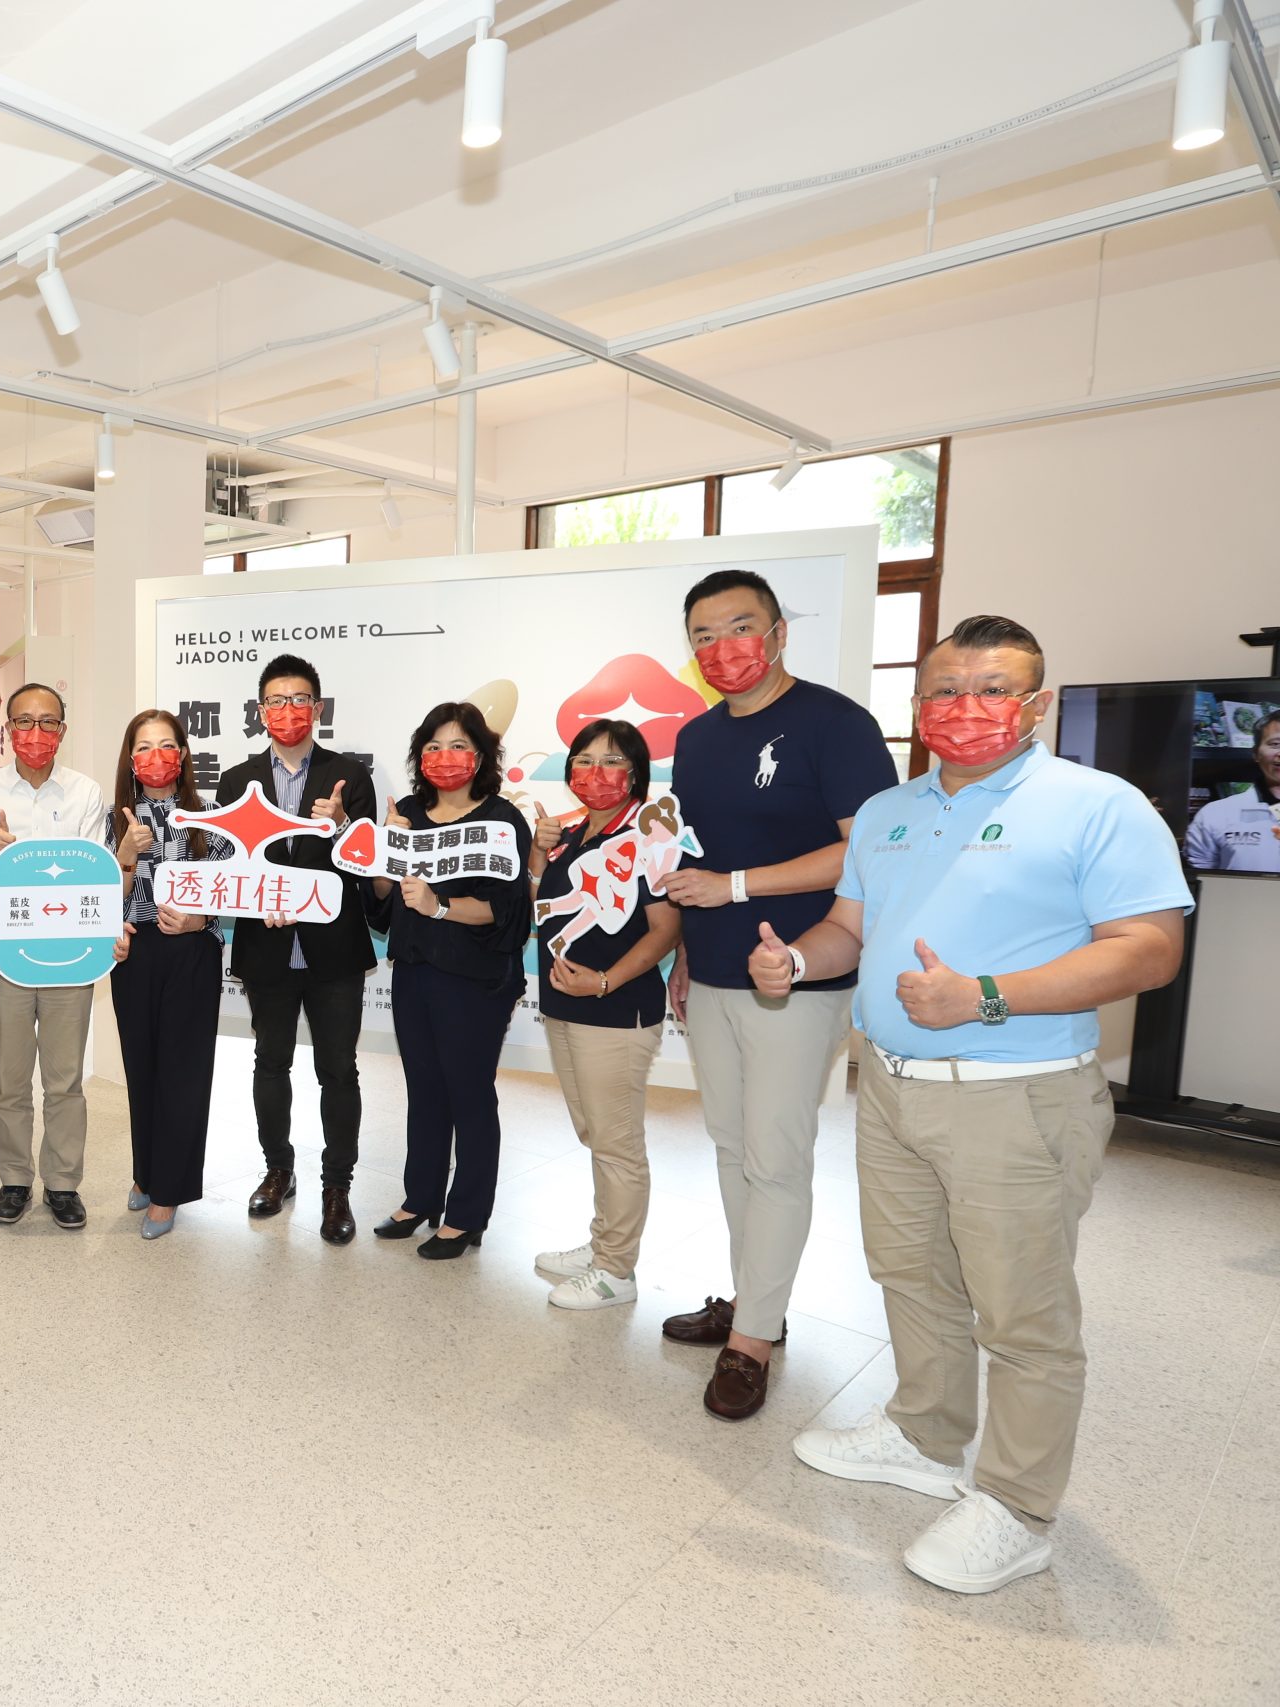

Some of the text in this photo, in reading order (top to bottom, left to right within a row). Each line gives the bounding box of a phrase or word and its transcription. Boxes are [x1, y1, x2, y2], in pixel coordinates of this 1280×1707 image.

[175, 631, 231, 646] HELLO
[251, 625, 348, 642] WELCOME
[357, 623, 383, 638] TO
[176, 648, 258, 665] JIADONG
[387, 825, 488, 853] 吹著海風
[12, 850, 34, 864] ROSY
[60, 850, 97, 863] EXPRESS
[385, 852, 513, 878] 長大的蓮霧
[80, 895, 100, 906] 透紅
[165, 870, 332, 917] 透紅佳人
[9, 897, 30, 908] 藍皮
[9, 909, 30, 920] 解憂
[80, 908, 100, 918] 佳人
